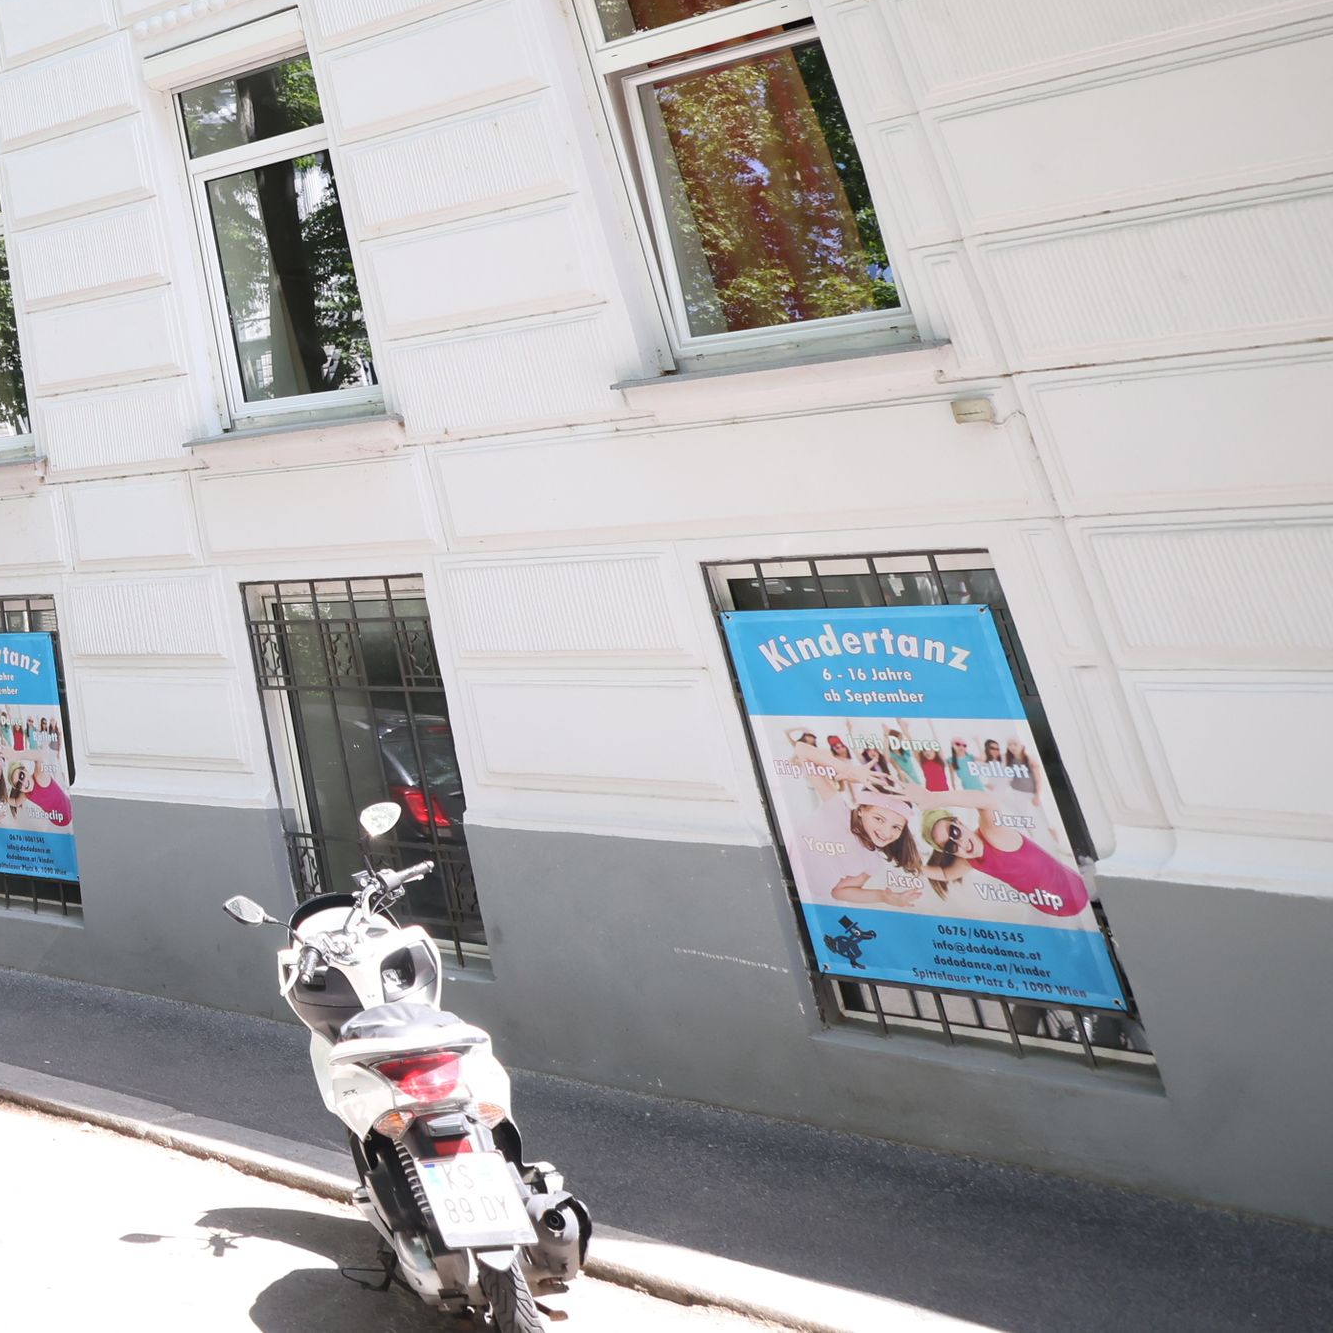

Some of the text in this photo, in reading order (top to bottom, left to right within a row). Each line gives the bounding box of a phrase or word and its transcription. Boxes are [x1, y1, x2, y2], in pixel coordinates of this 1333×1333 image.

[758, 624, 971, 673] Kindertanz
[822, 668, 832, 681] 6
[848, 668, 867, 681] 16
[871, 667, 912, 681] Jahre
[823, 689, 925, 705] ab September
[847, 734, 941, 753] Irish Dance
[773, 760, 837, 779] Hip Hop
[967, 761, 1030, 779] Ballett
[993, 811, 1035, 829] Jazz
[803, 836, 847, 857] Yoga
[886, 871, 923, 890] Acro
[974, 883, 1064, 911] Videoclip
[937, 924, 1025, 944] 0676/6061545
[933, 940, 1042, 961] info@dododance.at
[934, 955, 1051, 979] dododance.at/kinder
[912, 967, 1088, 999] Spittelauer Platz 6, 1090 Wien
[444, 1197, 476, 1224] 89
